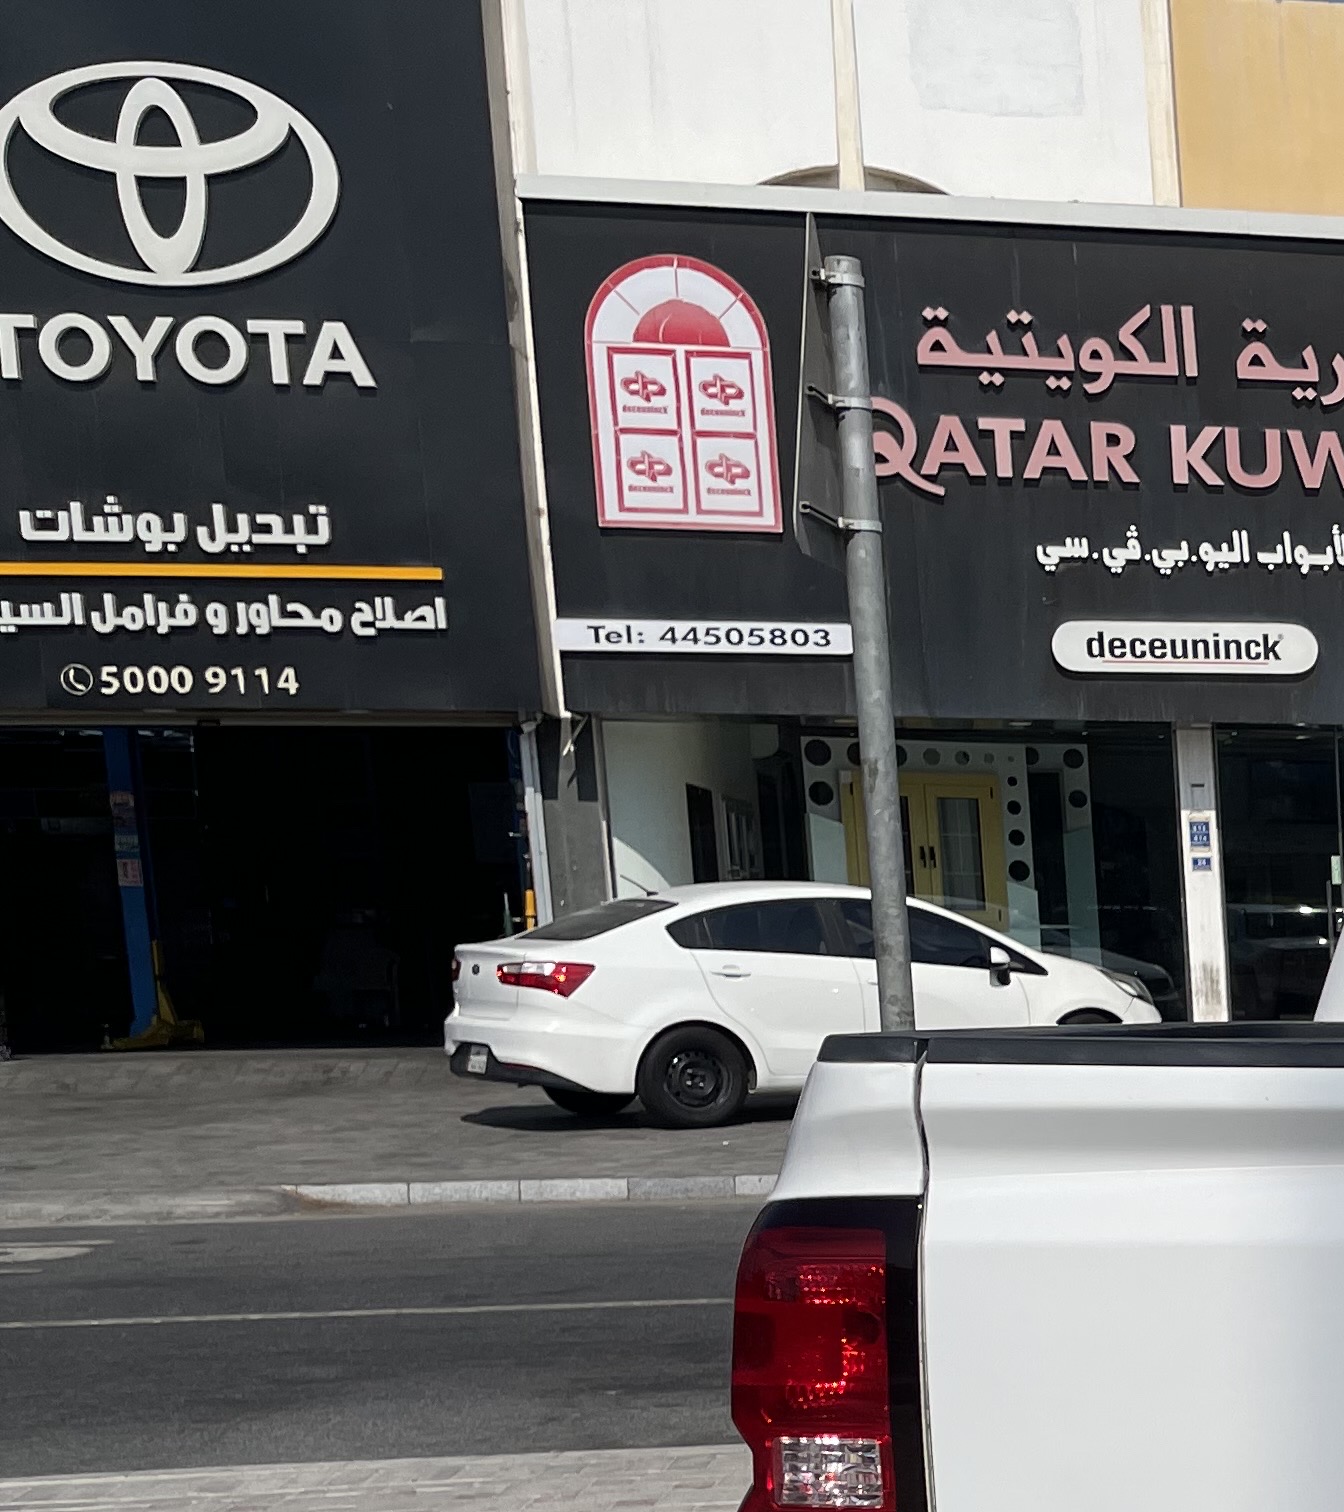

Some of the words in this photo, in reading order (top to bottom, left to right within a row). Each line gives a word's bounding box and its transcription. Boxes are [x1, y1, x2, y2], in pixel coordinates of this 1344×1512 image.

[0, 312, 377, 388] TOYOTA
[916, 304, 1198, 394] الكويتية
[18, 495, 186, 552] بوشات
[196, 503, 330, 554] تبديل
[0, 592, 84, 633] السي
[90, 592, 197, 634] فرامل
[205, 602, 228, 635] و
[235, 594, 343, 635] محاور
[350, 596, 447, 636] اصلاح
[586, 624, 644, 644] Tel:
[658, 625, 832, 648] 44505803
[1085, 630, 1283, 661] deceuninck
[100, 665, 194, 695] 5000
[204, 666, 299, 695] 9114
